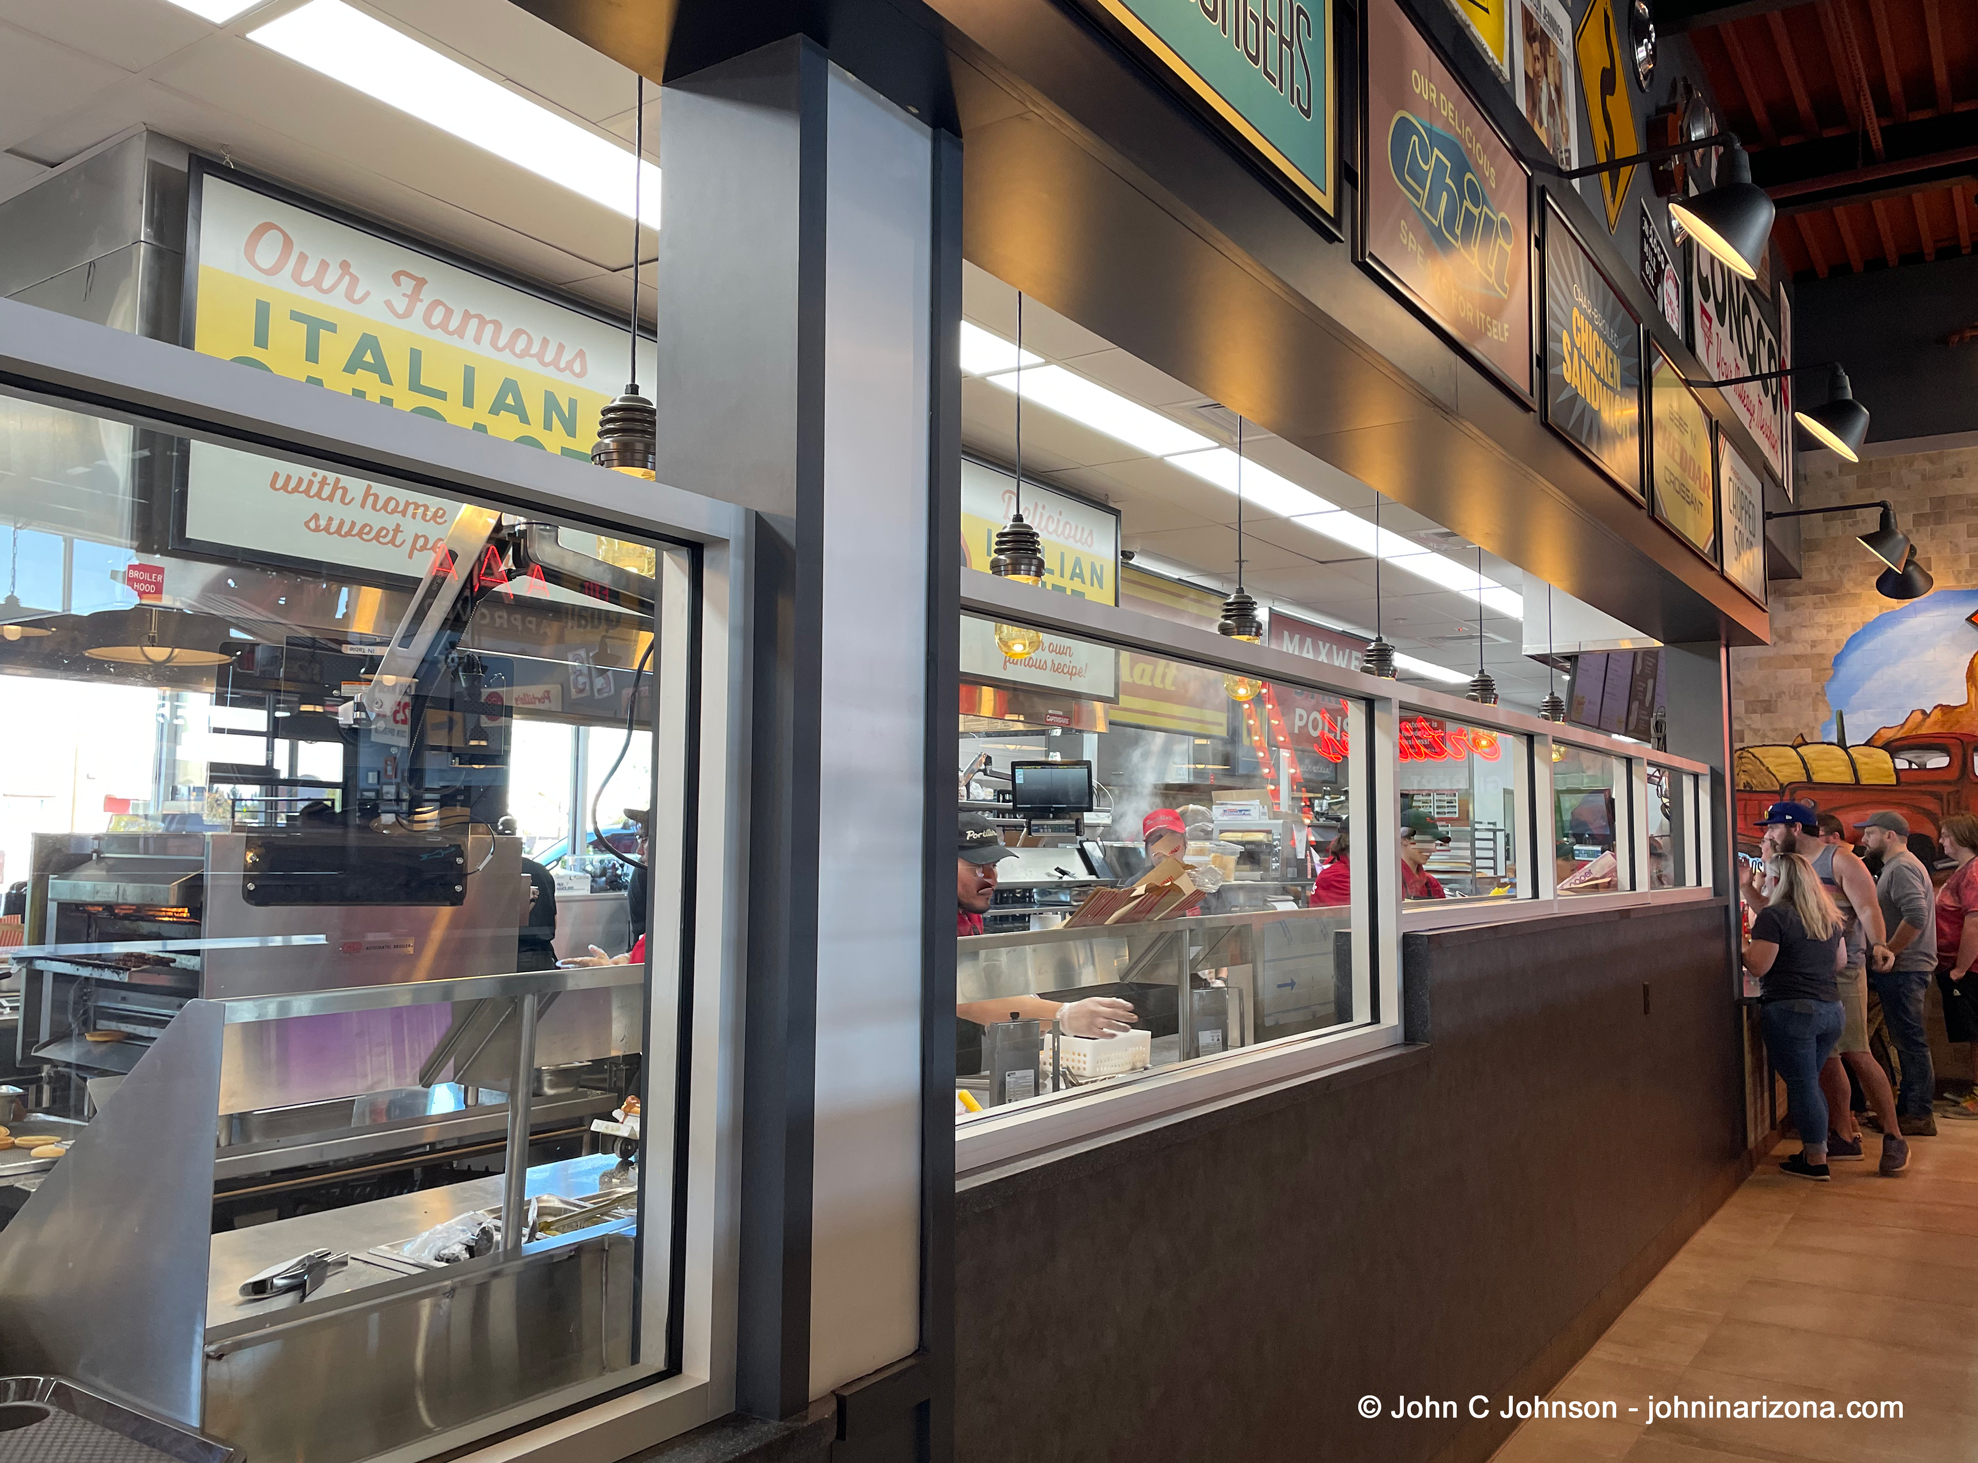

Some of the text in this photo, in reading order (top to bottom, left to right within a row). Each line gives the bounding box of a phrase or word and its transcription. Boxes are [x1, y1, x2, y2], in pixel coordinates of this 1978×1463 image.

[1411, 69, 1497, 190] OUR DELICIOUS
[1388, 109, 1514, 299] Chili
[243, 221, 588, 380] Our Famous
[1451, 287, 1474, 326] FOR
[1476, 308, 1510, 343] ITSELF
[1573, 283, 1619, 350] CHAR-BROILED
[253, 298, 578, 440] ITALIAN
[1572, 306, 1621, 392] CHICKEN
[1562, 329, 1631, 442] SANDWICH
[269, 470, 355, 507] with
[1654, 416, 1711, 501] CHEDDAR
[303, 511, 406, 549] sweet
[1728, 476, 1756, 539] CHOPPED
[128, 569, 163, 583] BROILER
[986, 527, 1104, 590] ILIAN
[1733, 524, 1755, 577] SALAD
[133, 581, 156, 593] HOOD
[1048, 641, 1074, 658] own
[1050, 658, 1088, 682] recipe!
[1283, 630, 1361, 672] MAXWE
